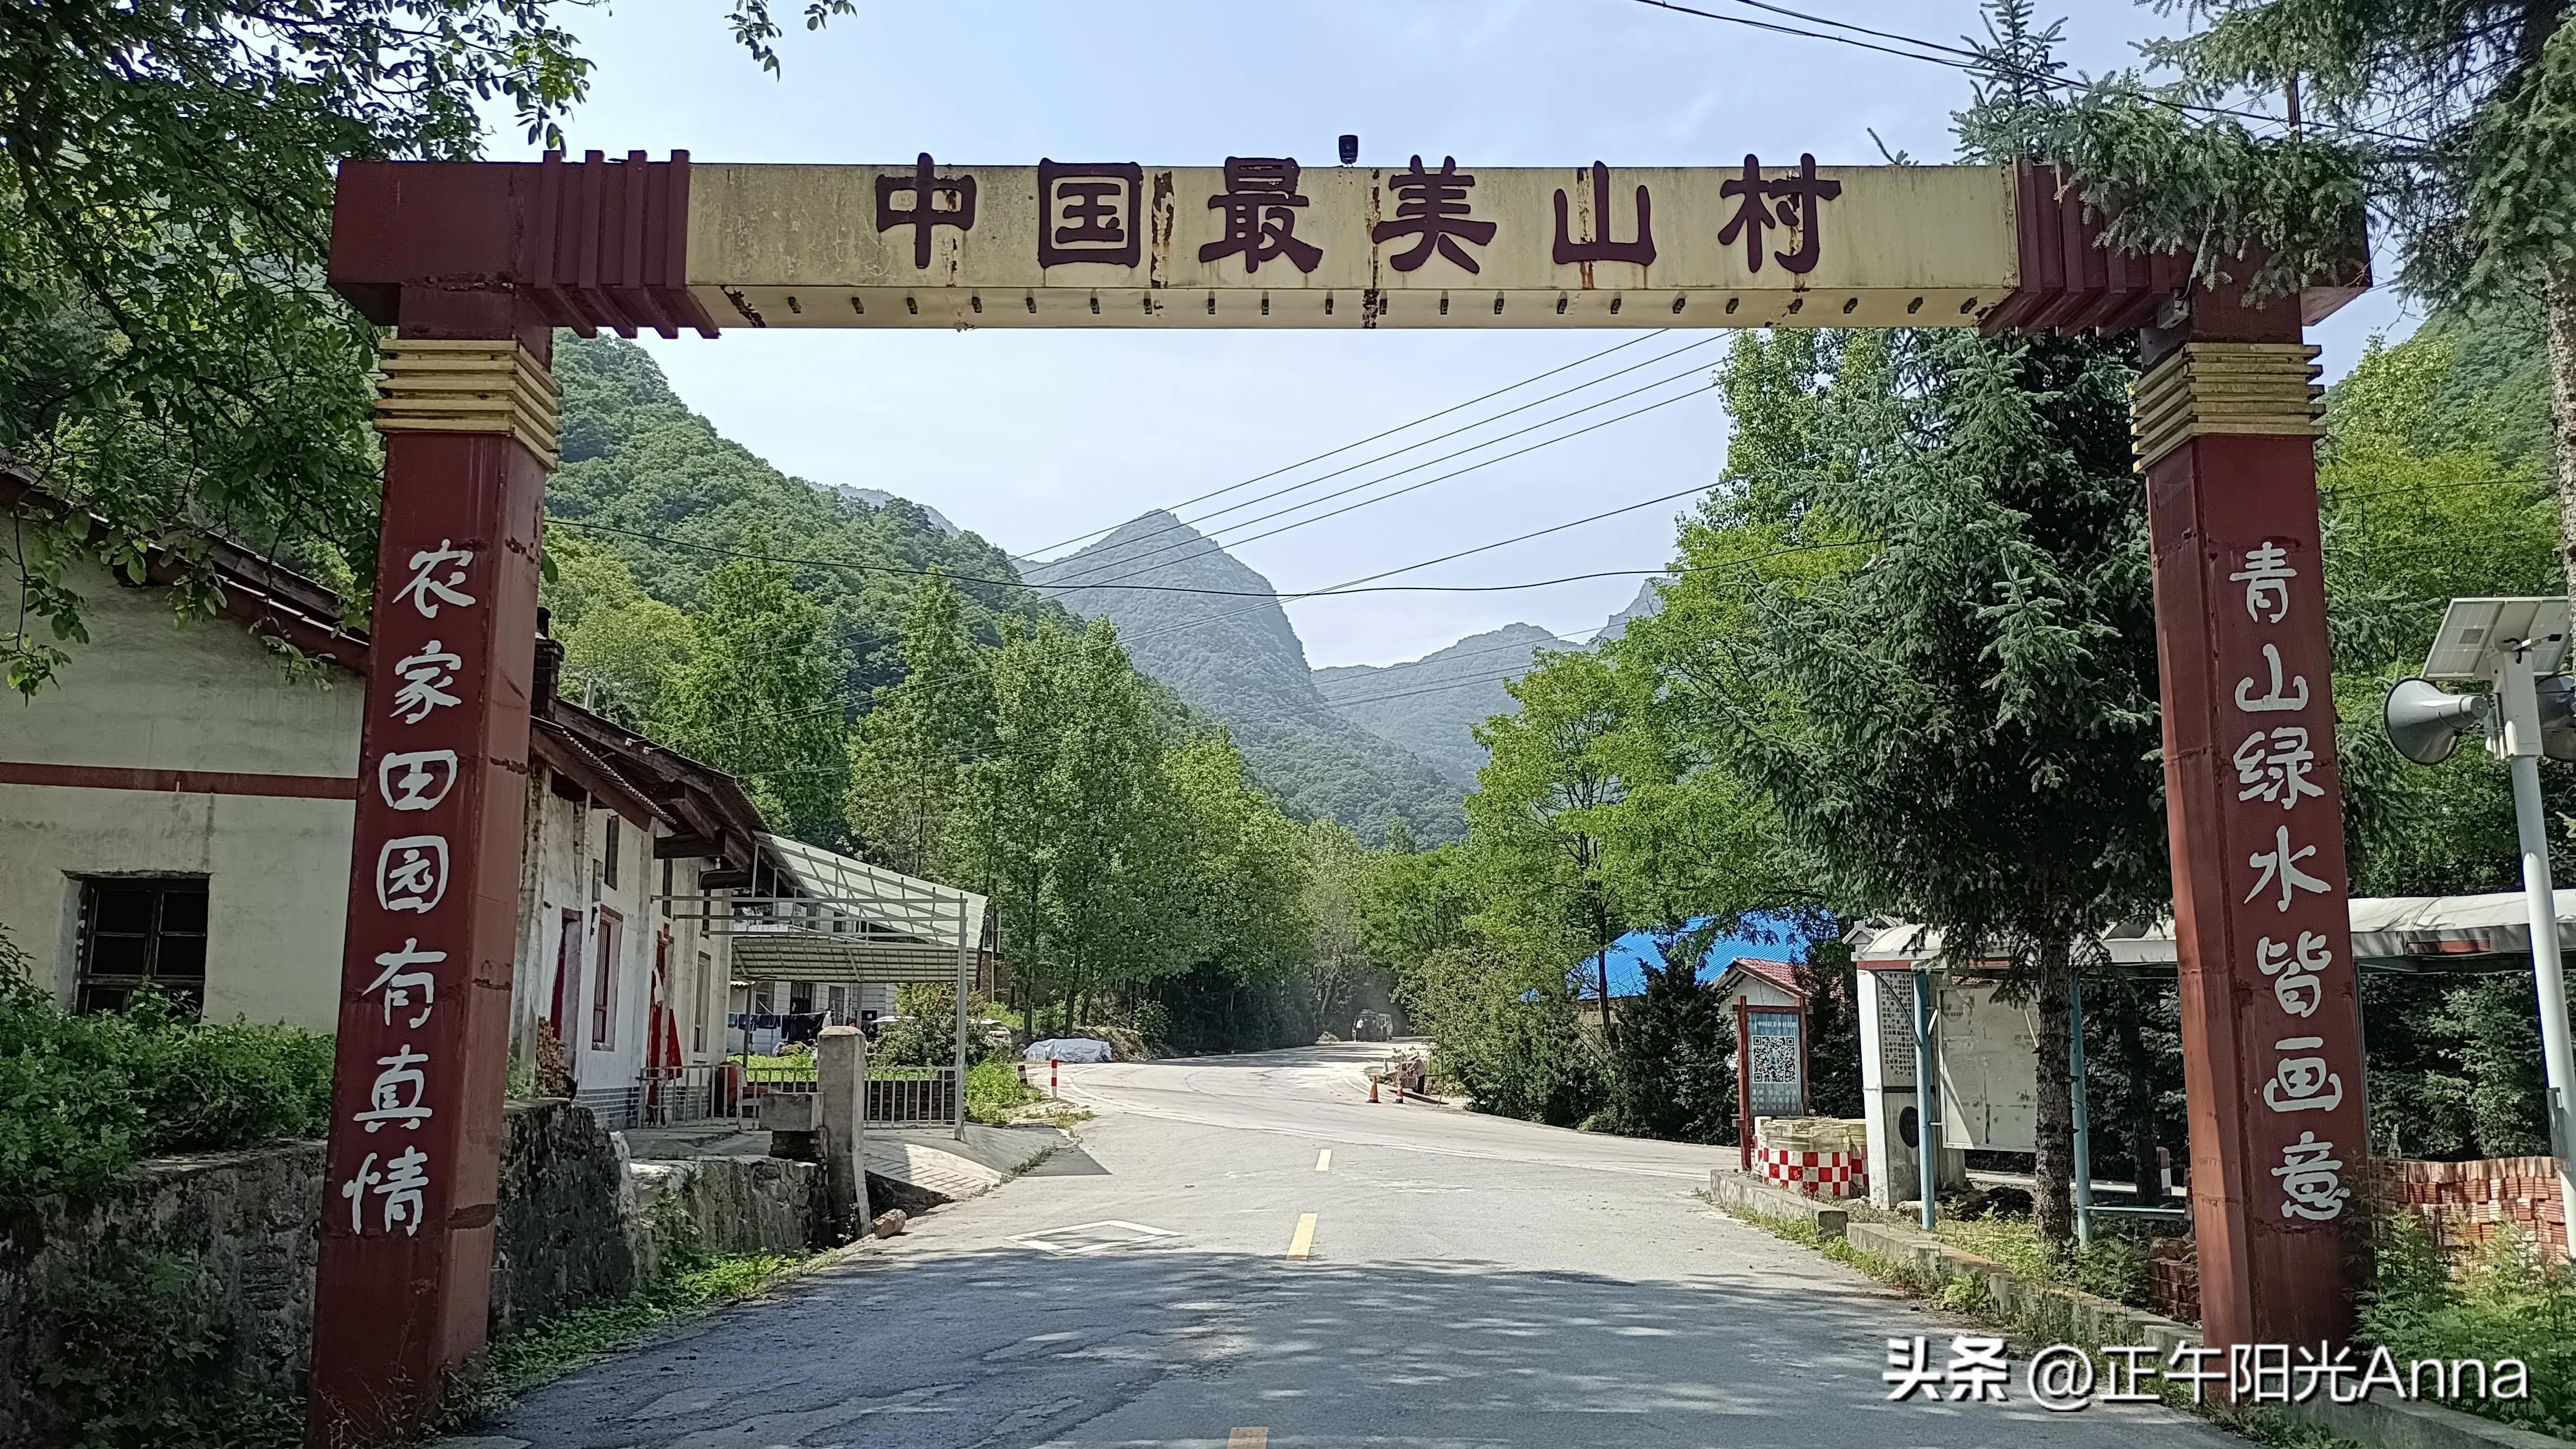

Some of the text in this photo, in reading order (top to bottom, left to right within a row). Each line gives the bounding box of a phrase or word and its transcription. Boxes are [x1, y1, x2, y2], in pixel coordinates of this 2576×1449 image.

[875, 152, 1841, 274] 中国最美山村
[342, 538, 476, 1236] 农家田园有真情
[2229, 541, 2350, 1220] 青山绿水皆画意
